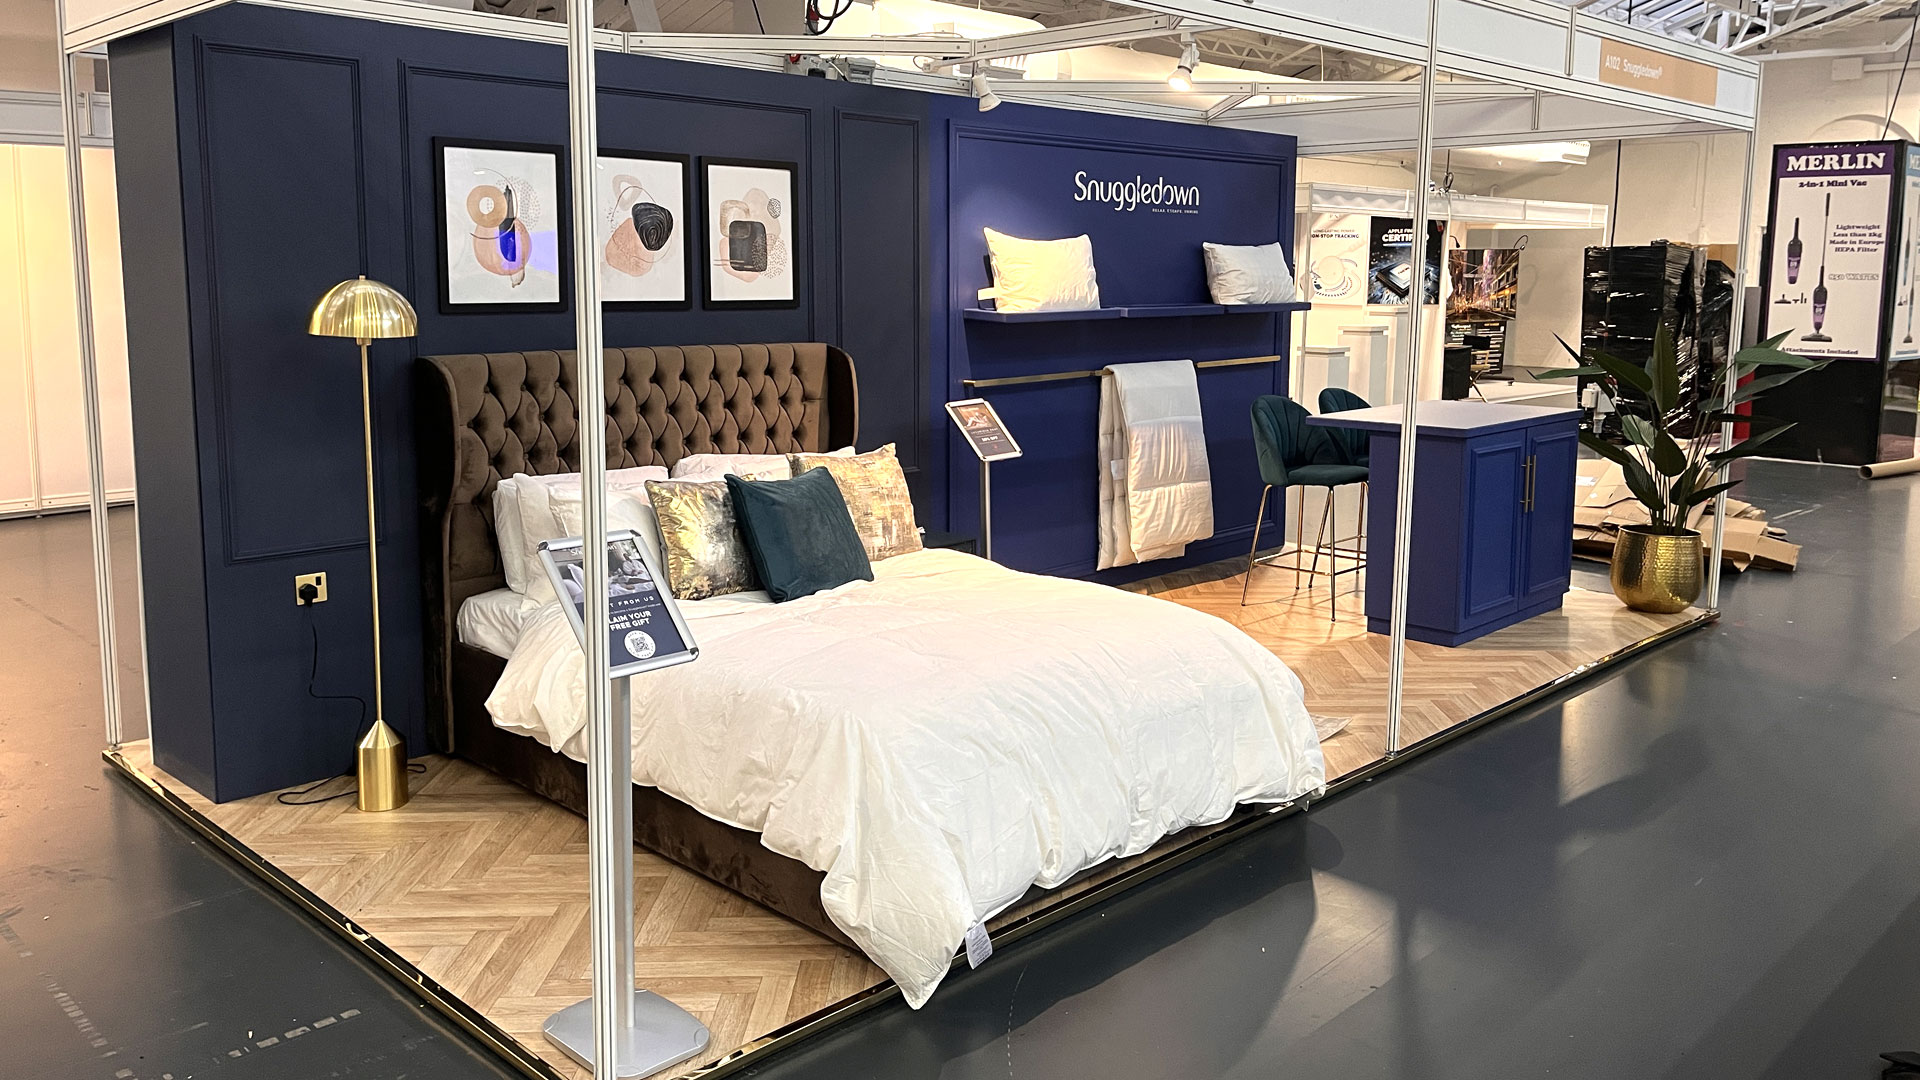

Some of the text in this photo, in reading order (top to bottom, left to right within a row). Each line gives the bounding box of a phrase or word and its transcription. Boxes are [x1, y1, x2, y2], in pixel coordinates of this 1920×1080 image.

[1605, 55, 1621, 70] A102
[1786, 152, 1886, 171] MERLIN
[1826, 179, 1847, 187] Mini
[1074, 170, 1199, 212] Snuggledown
[1382, 233, 1429, 242] CERTIF
[617, 598, 640, 607] FROM
[608, 610, 652, 624] LAIM YOUR
[610, 617, 650, 631] FREE GIFT
